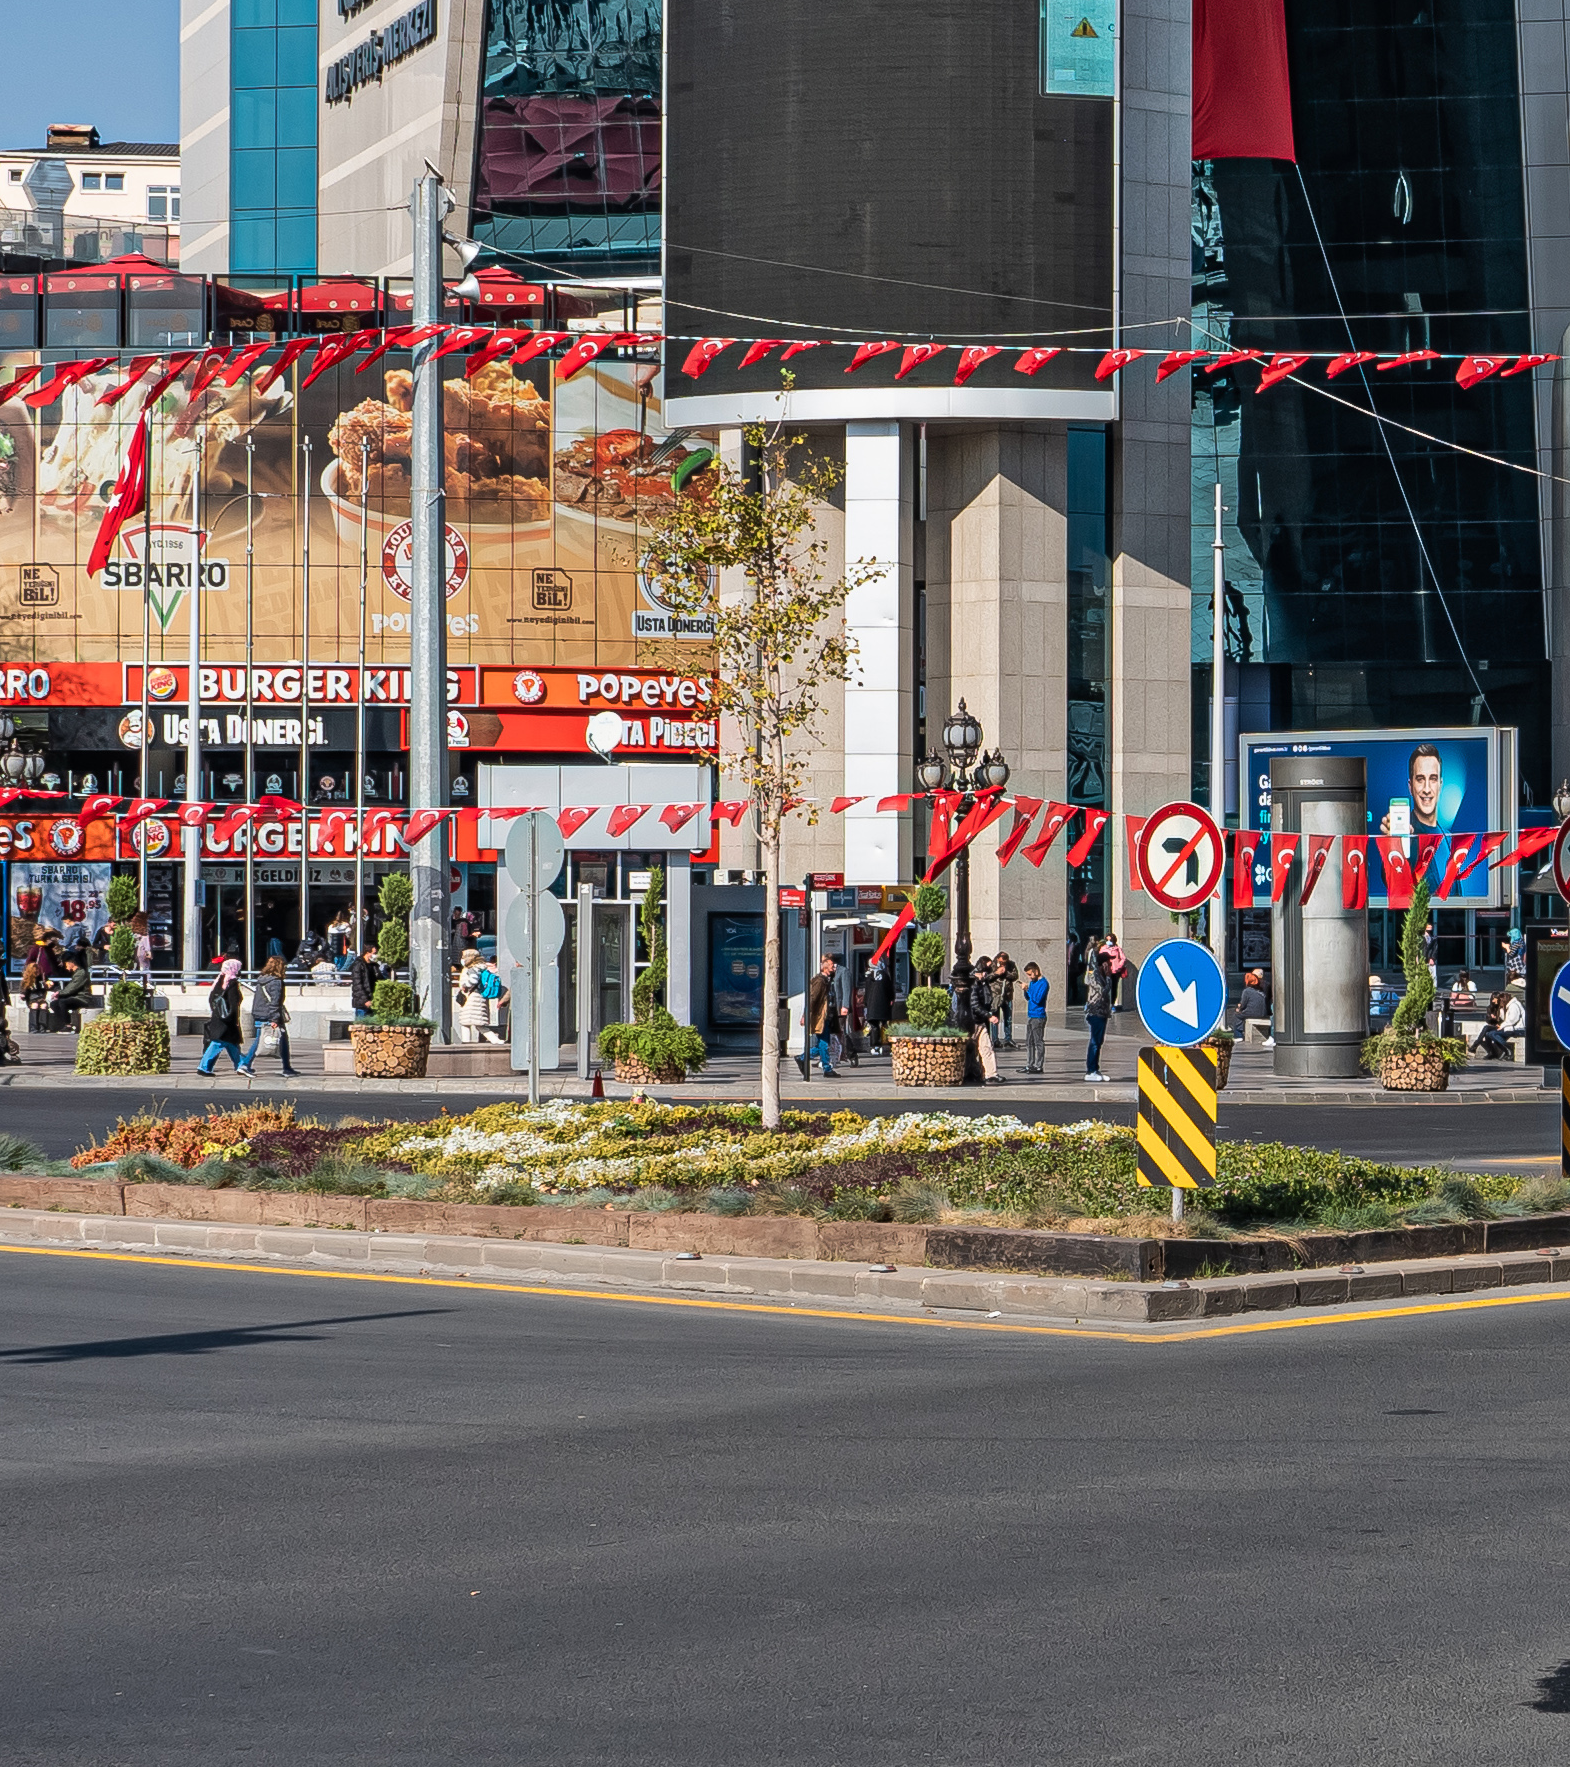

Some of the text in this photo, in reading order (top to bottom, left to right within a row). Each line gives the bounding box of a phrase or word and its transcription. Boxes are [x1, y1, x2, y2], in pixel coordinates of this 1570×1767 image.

[23, 568, 40, 580] NE
[537, 572, 553, 584] NE
[198, 668, 351, 700] BURGER
[42, 865, 78, 875] SBARRO
